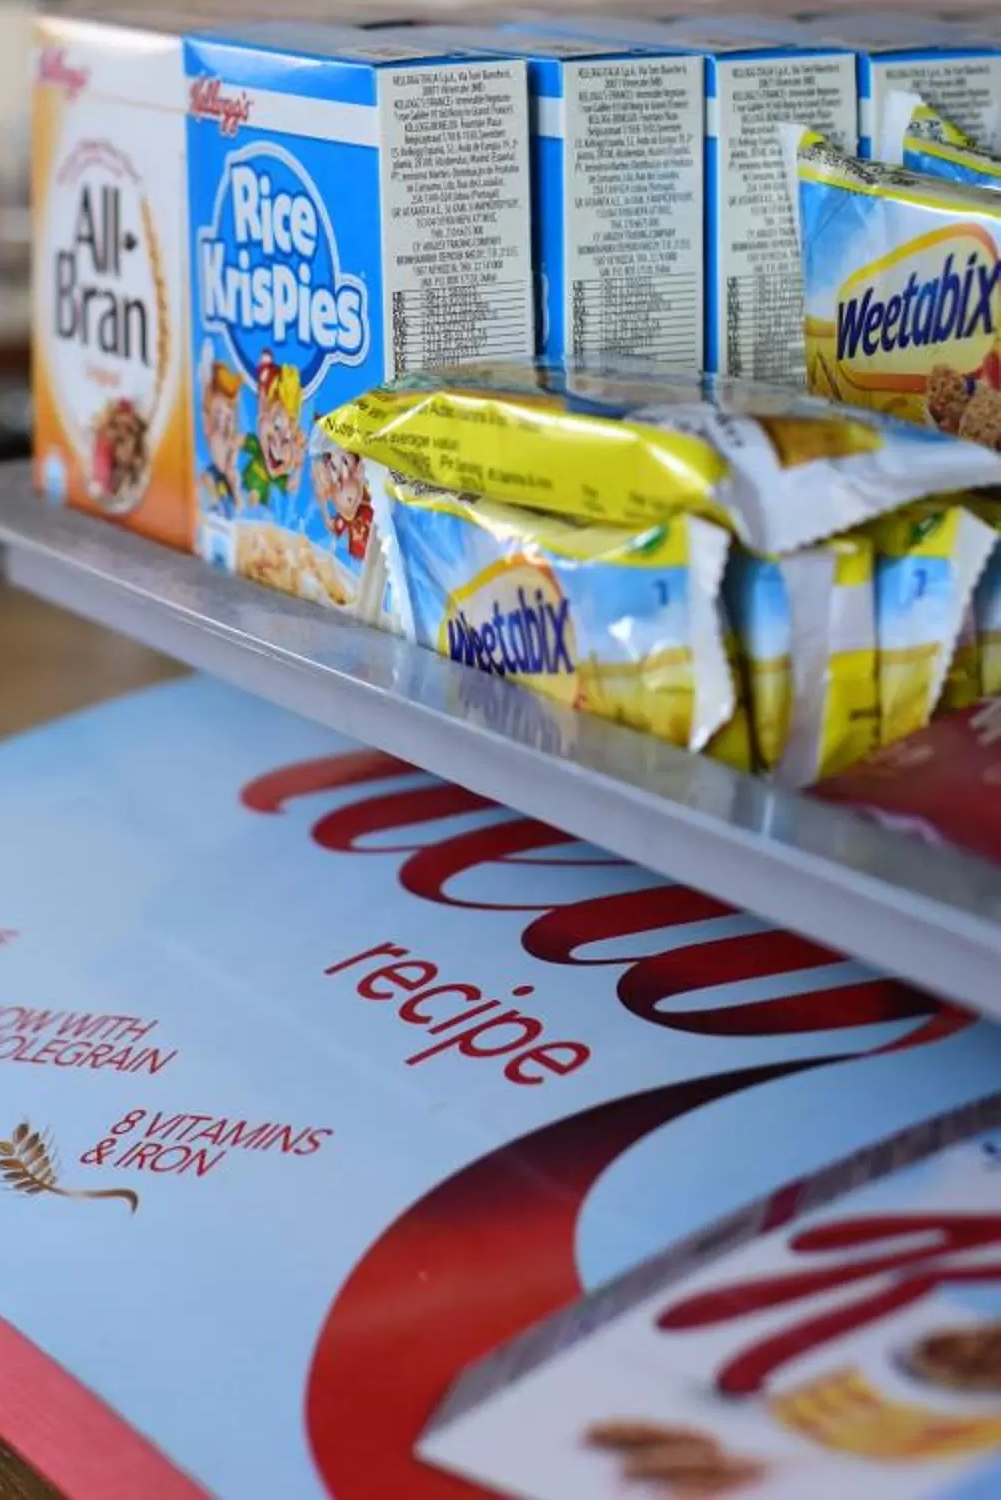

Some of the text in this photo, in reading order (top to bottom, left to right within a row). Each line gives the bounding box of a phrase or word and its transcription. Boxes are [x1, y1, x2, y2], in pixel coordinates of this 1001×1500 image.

[190, 78, 251, 136] Kellogg's
[230, 164, 318, 257] Rice
[56, 248, 151, 367] Bran
[202, 241, 365, 350] Krispies
[837, 252, 1001, 360] Weetabix
[448, 585, 575, 676] Weetabix
[56, 1011, 157, 1043] WITH
[324, 941, 591, 1085] recipe
[80, 1140, 225, 1178] & IRON
[110, 1108, 333, 1157] 8 VITAMINS
